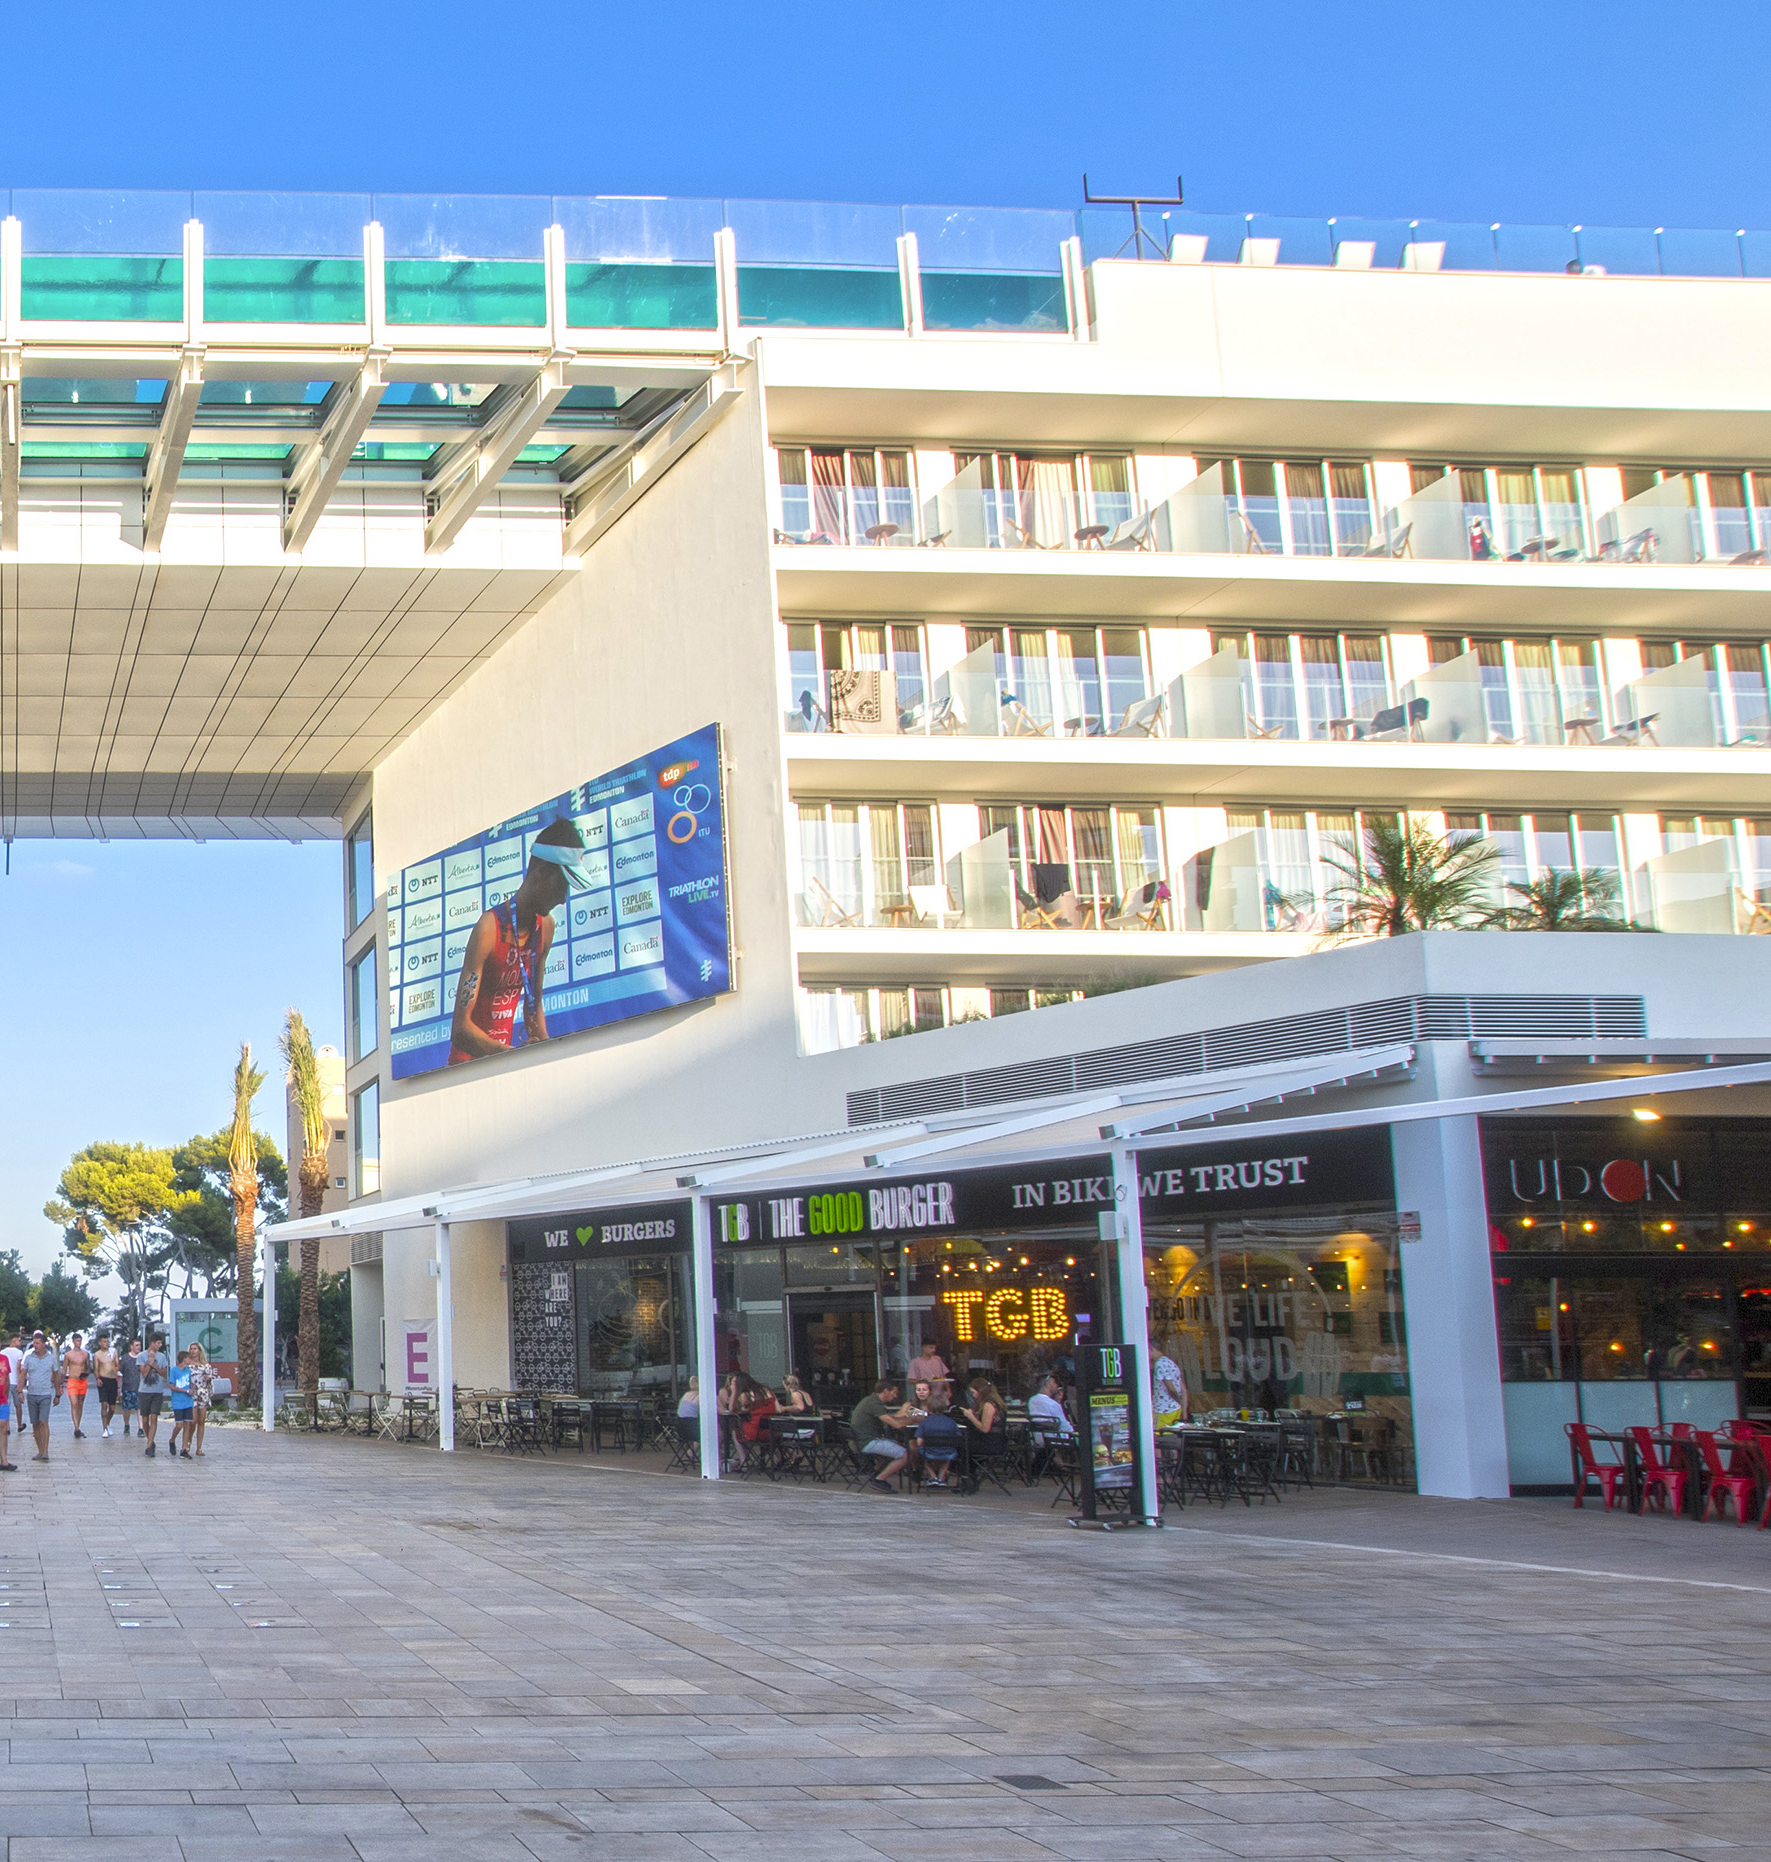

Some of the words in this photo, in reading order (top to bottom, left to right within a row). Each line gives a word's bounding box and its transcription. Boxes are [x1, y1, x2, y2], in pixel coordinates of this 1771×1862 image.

[589, 780, 611, 795] WORLD
[612, 769, 646, 788] TRIATHLON
[663, 767, 680, 782] tdp
[590, 786, 625, 804] EDMONTON
[506, 814, 538, 831] EDMONTON
[615, 810, 649, 829] Canada
[586, 825, 604, 837] NTT
[698, 827, 710, 838] ITU
[487, 851, 520, 868] Edmonton
[616, 850, 654, 869] Edmonton
[448, 864, 474, 880] Alberta
[421, 875, 438, 887] NTT
[669, 875, 719, 898] TRIATHLON
[622, 889, 653, 906] EXPLORE
[449, 901, 478, 917] Canada
[590, 906, 608, 918] NTT
[622, 901, 654, 916] EDMONTON
[408, 914, 436, 929] Alberta
[623, 937, 659, 955] Canada
[421, 953, 439, 965] NTT
[576, 949, 613, 966] Edmonton
[409, 988, 435, 1004] EXPLORE
[492, 988, 519, 1006] ESP
[408, 1000, 436, 1014] EDMONTON
[1012, 1182, 1046, 1208] IN
[1136, 1168, 1185, 1198] WE
[1190, 1156, 1309, 1193] TRUST
[1510, 1159, 1680, 1202] UDON
[718, 1203, 750, 1243] TGB
[769, 1197, 805, 1239] THE
[808, 1191, 864, 1235] GOOD
[868, 1181, 955, 1231] BURGER
[544, 1230, 569, 1248] WE
[601, 1219, 676, 1244] BURGERS
[545, 1287, 568, 1300] WHERE
[545, 1302, 557, 1313] ARE
[943, 1288, 1070, 1341] TGB
[1251, 1290, 1312, 1327] LIFE
[407, 1332, 429, 1383] E
[1100, 1347, 1123, 1378] TGB
[1202, 1335, 1298, 1382] LOUD
[1091, 1396, 1116, 1405] MENUS
